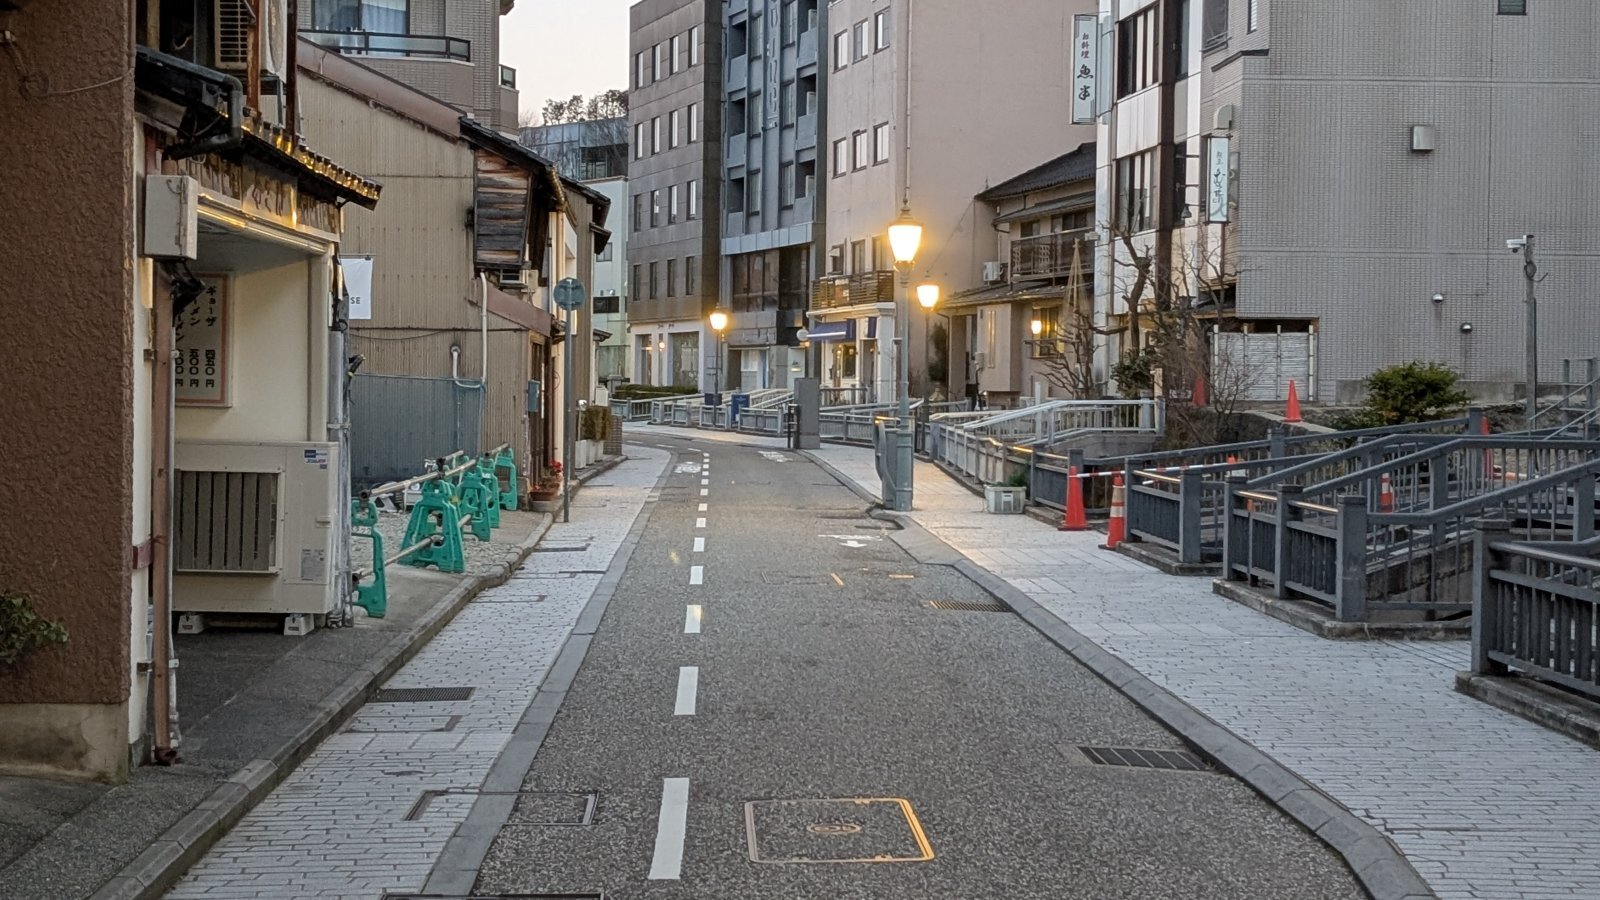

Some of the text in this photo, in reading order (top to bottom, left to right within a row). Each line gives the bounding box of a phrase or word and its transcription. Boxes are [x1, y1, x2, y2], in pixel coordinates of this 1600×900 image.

[190, 298, 201, 327] ーメン
[205, 285, 217, 388] ギョーザ 四五〇円
